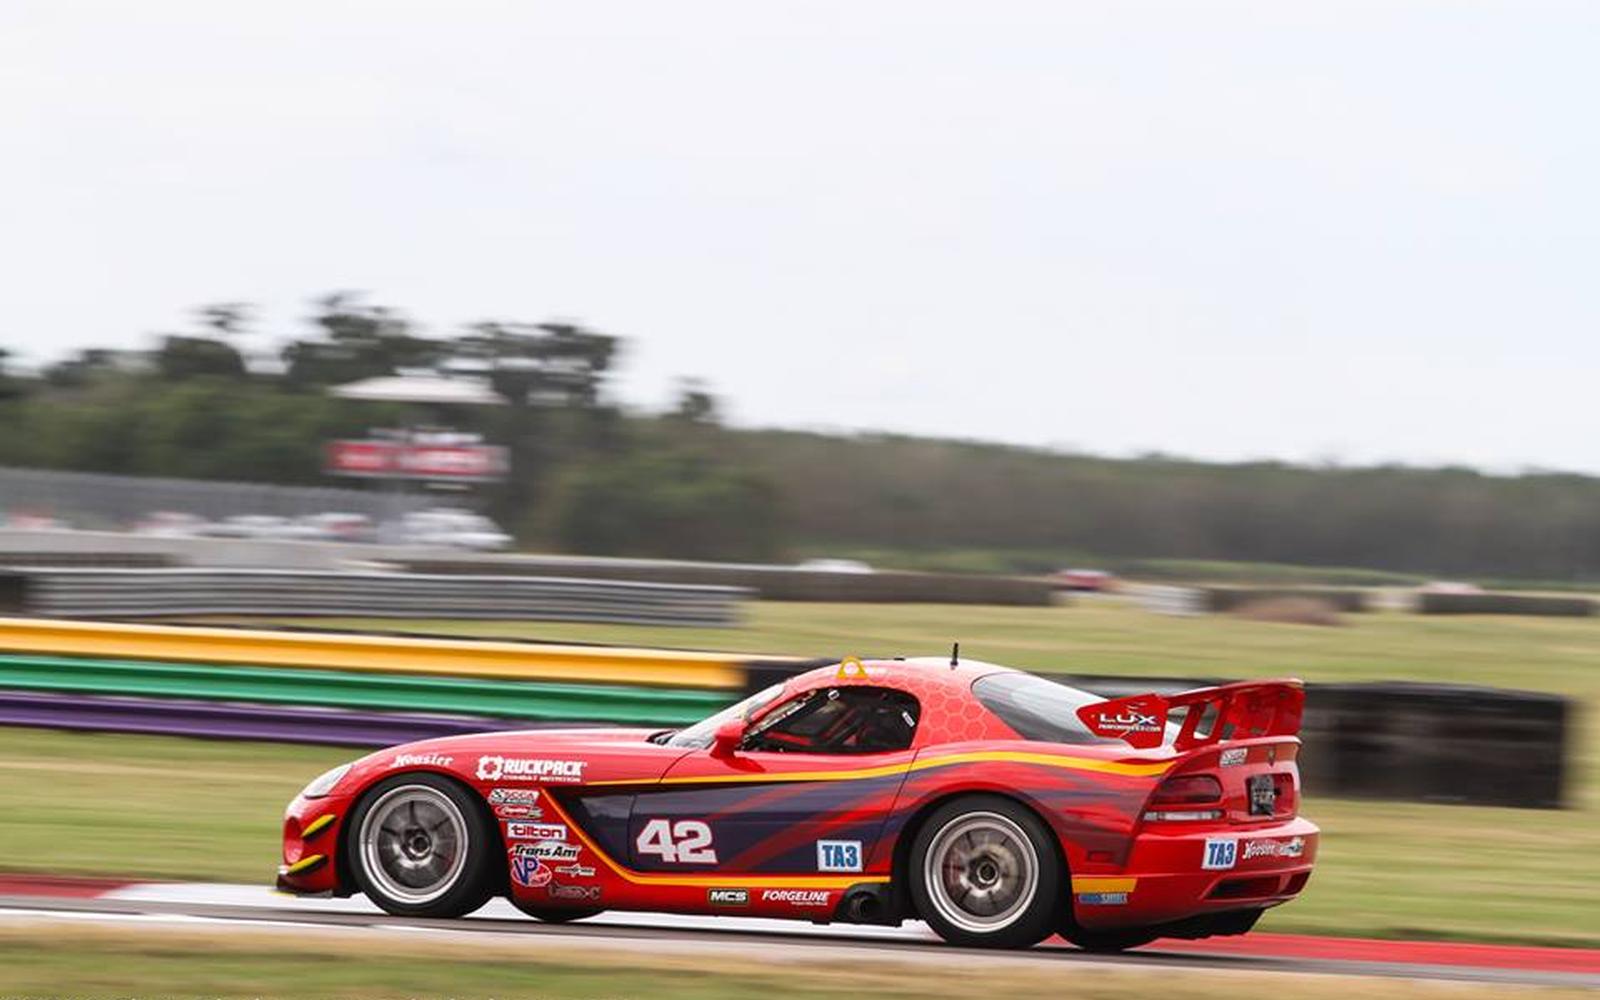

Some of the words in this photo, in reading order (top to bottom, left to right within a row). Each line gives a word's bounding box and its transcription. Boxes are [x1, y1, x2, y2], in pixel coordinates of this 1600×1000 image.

[1099, 713, 1158, 725] LUX
[503, 760, 582, 776] RUCKPACK
[511, 825, 563, 837] tilton
[636, 818, 719, 864] 42
[515, 844, 552, 857] Trans
[551, 846, 577, 858] Am
[822, 845, 858, 868] TA3
[1208, 843, 1235, 866] TA3
[513, 857, 539, 886] VP
[710, 891, 747, 901] MCS
[761, 890, 830, 901] FORGELINE
